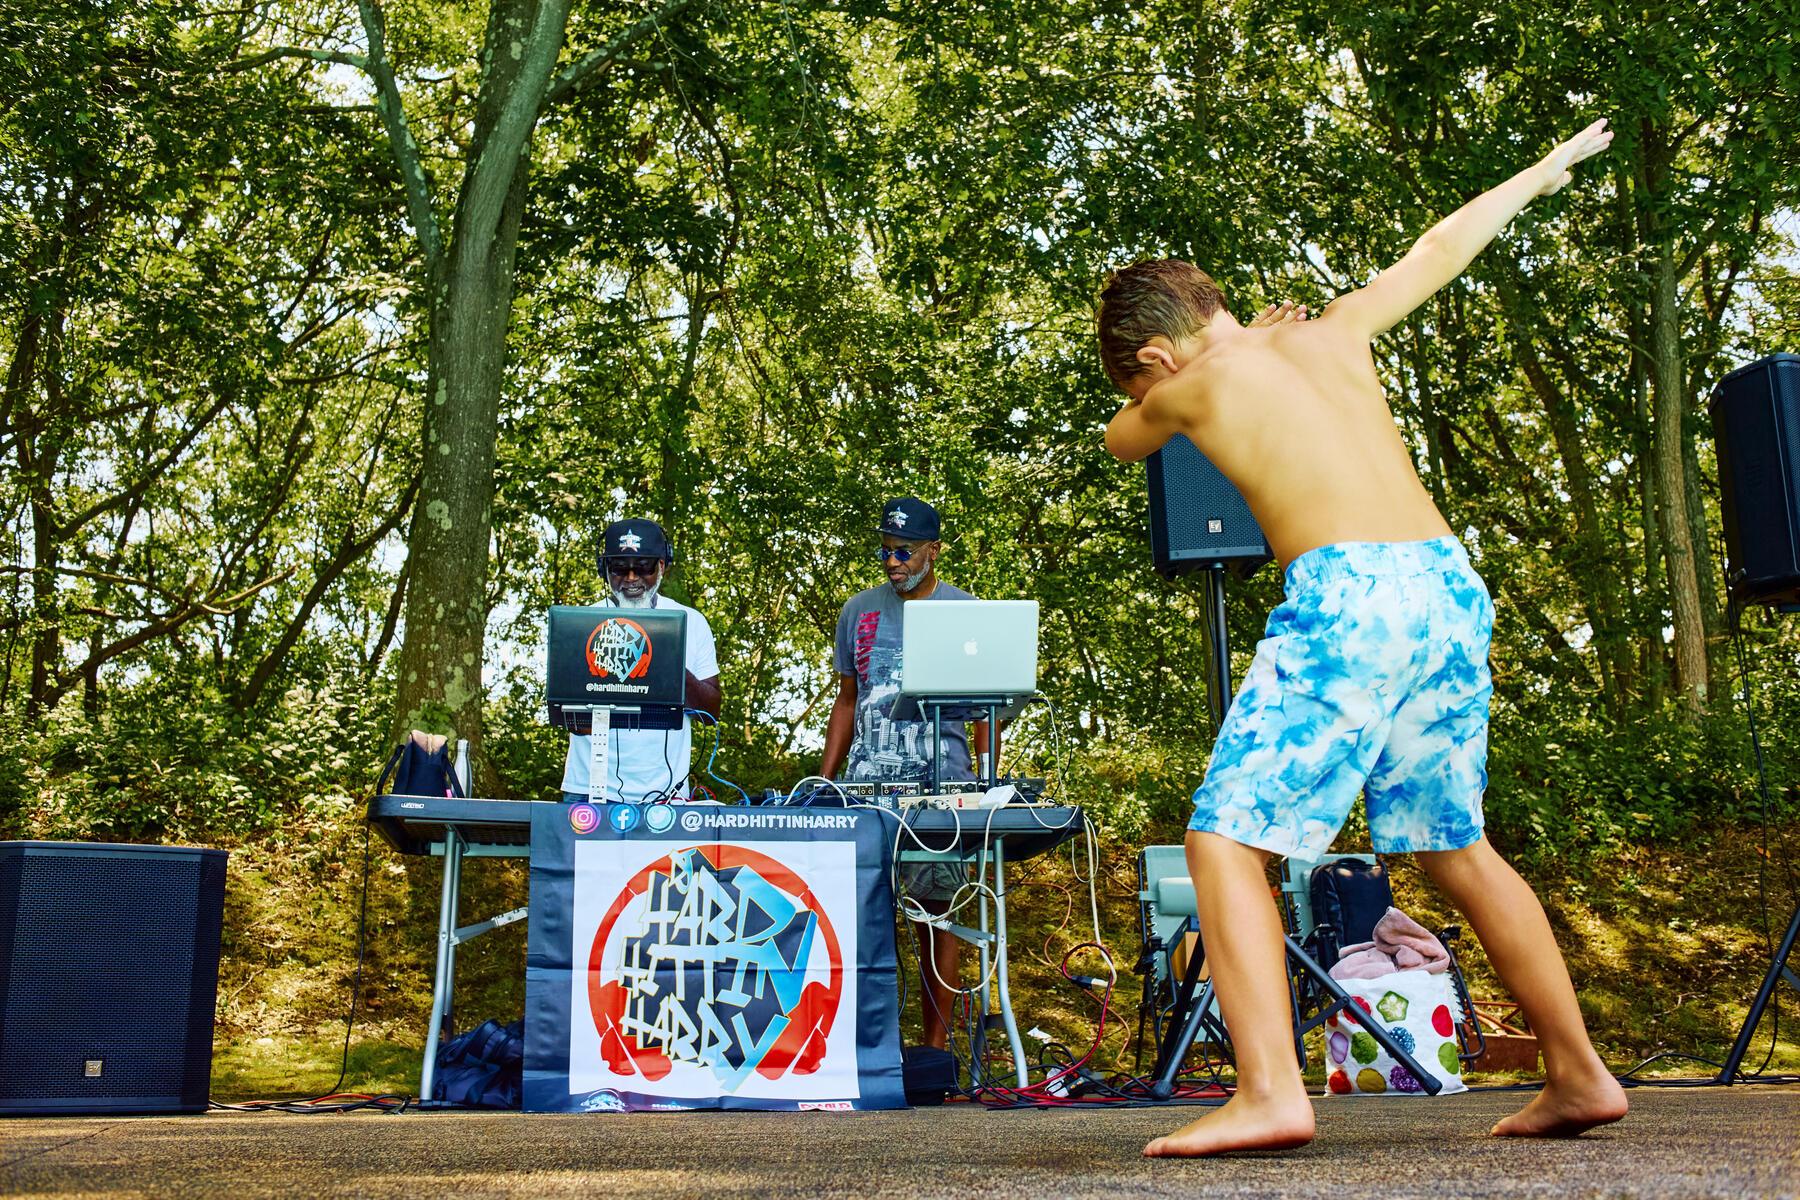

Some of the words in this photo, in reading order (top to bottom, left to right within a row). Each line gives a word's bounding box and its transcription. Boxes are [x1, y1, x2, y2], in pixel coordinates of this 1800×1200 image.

[600, 623, 641, 645] HARD
[586, 683, 649, 694] @hardhittinharry
[681, 811, 858, 832] @HARDHITTINHARRY
[638, 865, 798, 944] HARD
[616, 909, 819, 1016] HITTIN
[618, 990, 792, 1092] HARRY
